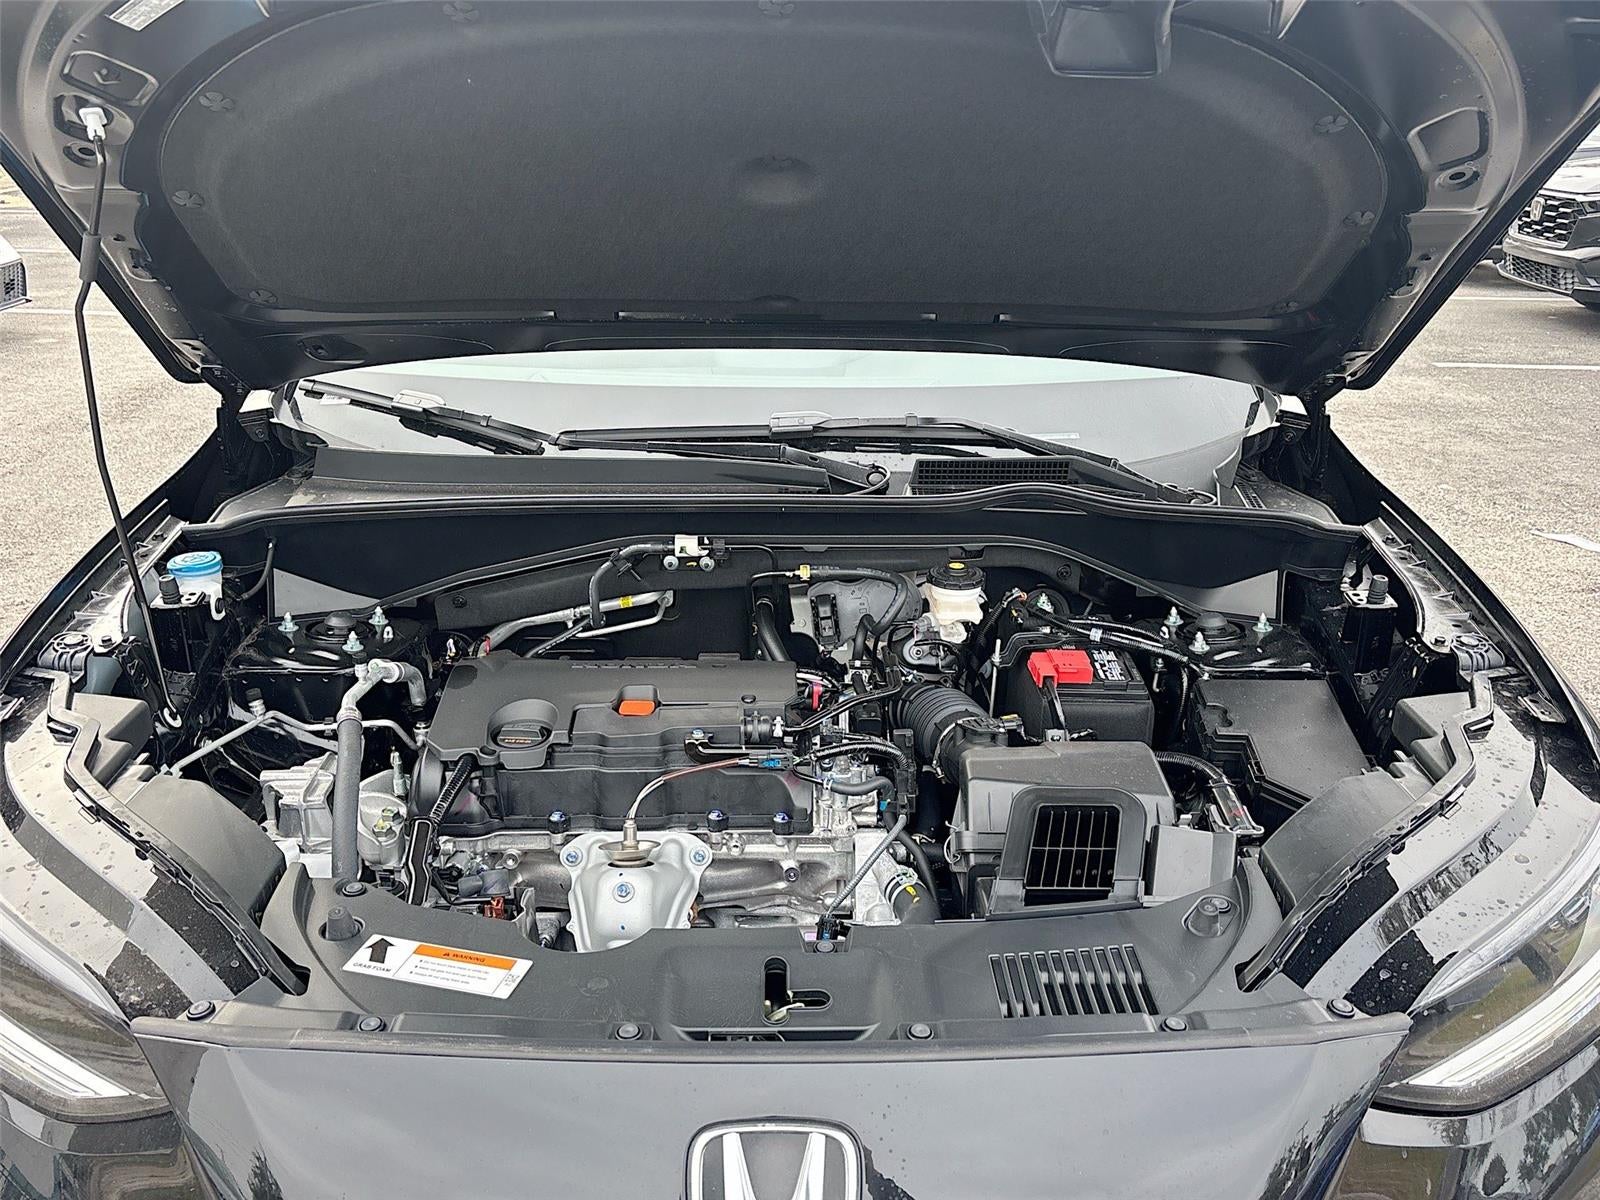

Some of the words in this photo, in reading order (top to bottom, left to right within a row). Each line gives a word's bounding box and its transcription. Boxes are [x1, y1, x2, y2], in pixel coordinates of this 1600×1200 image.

[452, 953, 486, 963] WARNING
[352, 961, 372, 970] GRAB
[371, 964, 392, 973] FOAM
